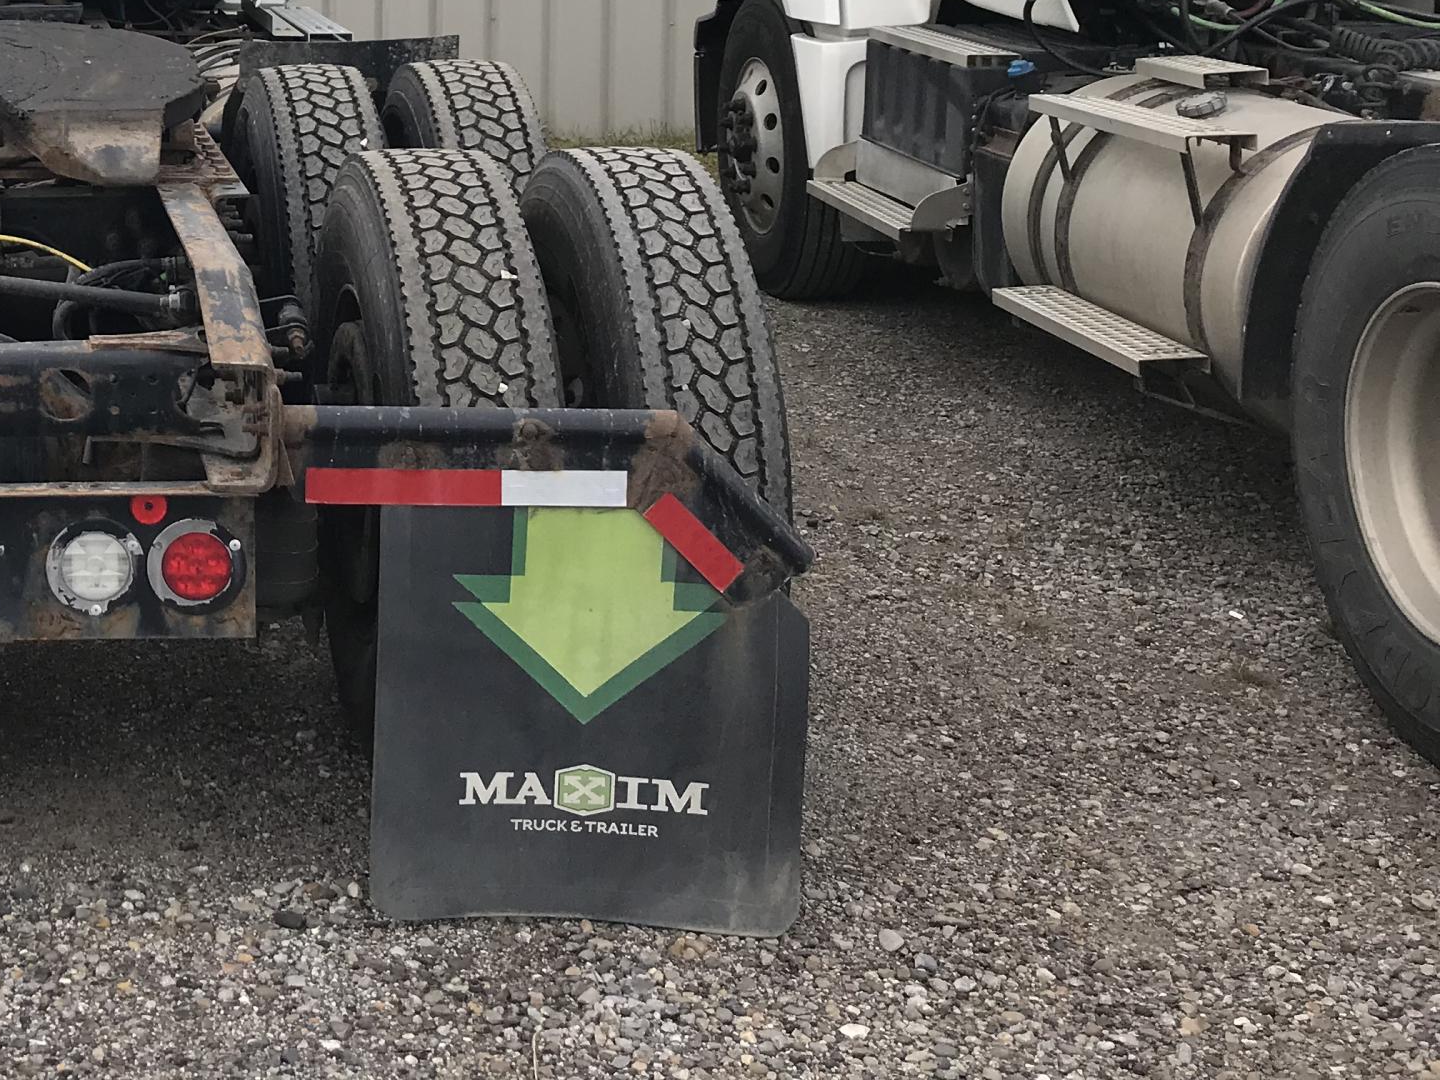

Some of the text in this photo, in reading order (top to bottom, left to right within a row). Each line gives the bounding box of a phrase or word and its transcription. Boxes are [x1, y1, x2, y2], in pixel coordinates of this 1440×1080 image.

[458, 764, 710, 816] MAXIM
[510, 818, 659, 838] TRUCK & TRAILER
